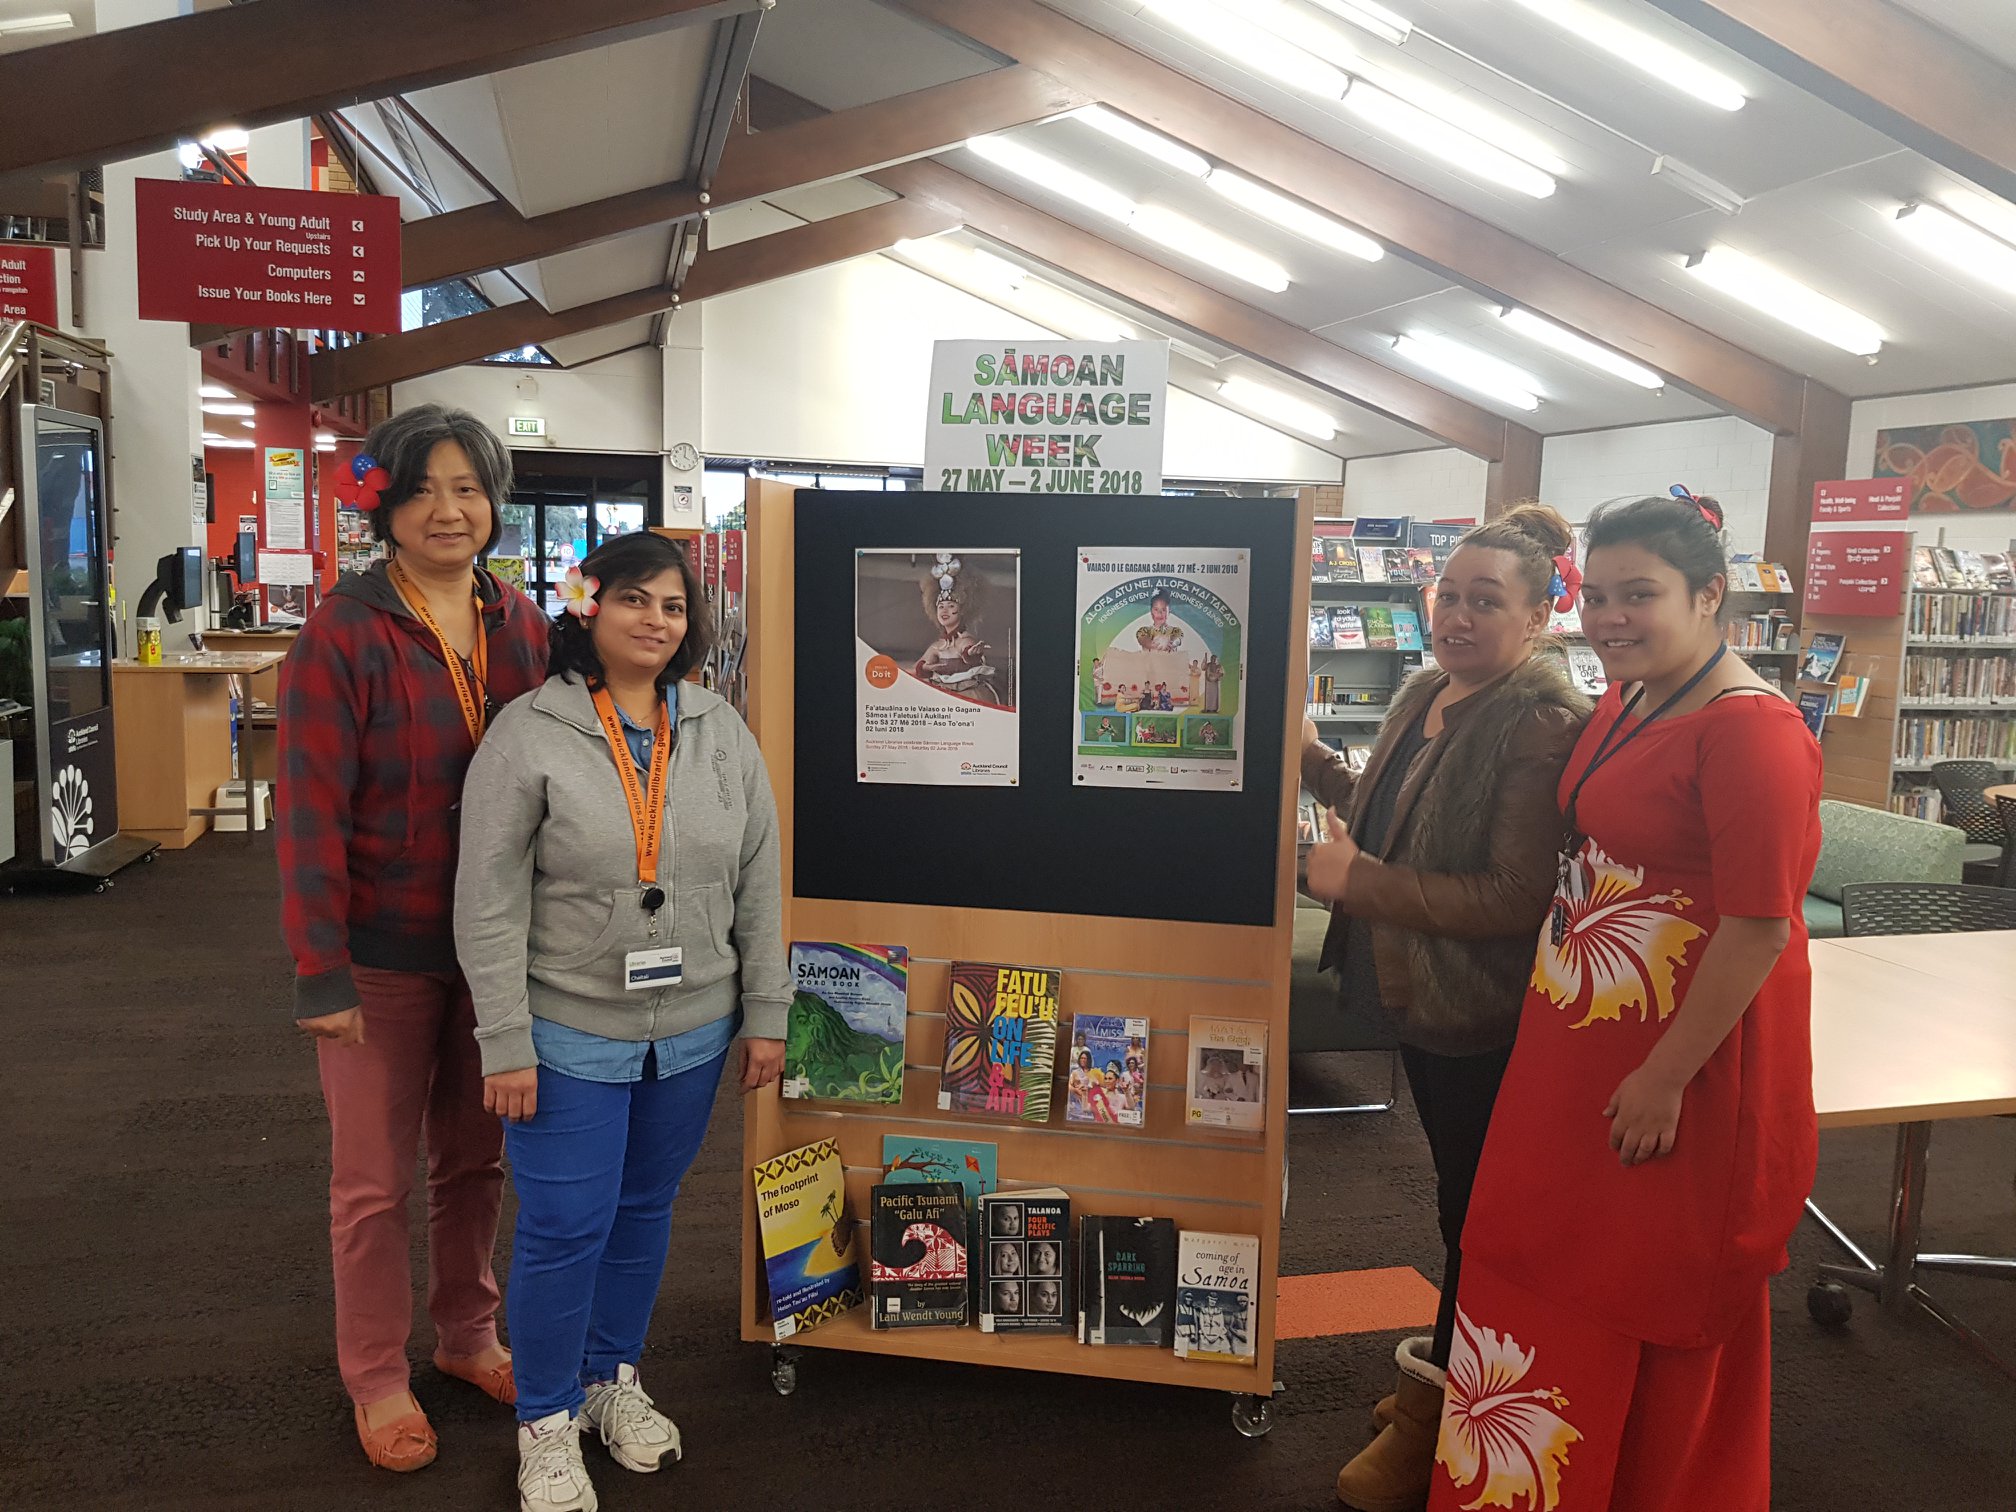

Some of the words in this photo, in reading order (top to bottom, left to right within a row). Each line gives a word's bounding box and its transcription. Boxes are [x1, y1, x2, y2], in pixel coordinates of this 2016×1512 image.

[174, 207, 208, 224] Study
[213, 210, 240, 223] Area
[245, 213, 254, 224] &
[259, 213, 295, 229] Young
[300, 216, 330, 230] Adult
[306, 232, 331, 240] Upstairs
[196, 234, 220, 248] Pick
[225, 236, 240, 251] Up
[244, 238, 271, 251] Your
[276, 240, 331, 255] Requests
[2, 259, 26, 270] Adult
[268, 264, 331, 280] Computers
[199, 285, 230, 299] Issue
[234, 287, 262, 300] Your
[266, 289, 300, 303] Books
[305, 292, 332, 305] Here
[4, 304, 26, 315] Area
[974, 348, 1125, 386] SĀMOAN
[941, 392, 1151, 425] LANGUAGE
[516, 420, 538, 433] EXIT
[986, 434, 1102, 468] WEEK
[941, 469, 962, 492] 27
[967, 469, 1005, 492] MAY
[1030, 470, 1041, 492] 2
[1046, 470, 1094, 493] JUNE
[1099, 471, 1142, 494] 2018
[1429, 534, 1447, 546] TOP
[1449, 535, 1464, 547] PIC
[1087, 563, 1111, 573] VAIASO
[1112, 563, 1116, 573] O
[1117, 563, 1124, 573] LE
[1125, 563, 1150, 573] GAGANA
[1177, 564, 1186, 574] 27
[1201, 565, 1205, 574] 2
[1221, 565, 1238, 574] 2018
[1085, 597, 1114, 625] ALOFA
[1114, 584, 1133, 599] ATU
[1156, 578, 1189, 592] ALOFA
[1191, 586, 1210, 600] MAI
[1210, 595, 1237, 626] TAEAO
[1098, 598, 1128, 624] KINDNESS
[1128, 591, 1149, 604] GIVEN
[1170, 590, 1203, 608] KINDNESS
[872, 670, 884, 678] Do
[885, 670, 891, 678] it
[1577, 664, 1598, 672] YEAR
[1581, 670, 1596, 678] ONE
[955, 706, 981, 714] Gagana
[798, 963, 860, 981] SĀMOAN
[997, 969, 1048, 997] FATU
[995, 992, 1054, 1021] FEU'U
[993, 1015, 1024, 1041] ON
[1100, 1028, 1122, 1037] MISS
[990, 1040, 1034, 1067] LIFE
[989, 1063, 1005, 1087] &
[985, 1087, 1029, 1114] ART
[1192, 1110, 1202, 1118] PG
[761, 1186, 779, 1202] The
[780, 1172, 819, 1198] footprint
[763, 1206, 774, 1218] of
[775, 1198, 800, 1216] Moso
[880, 1194, 913, 1207] Pacific
[915, 1193, 958, 1206] Tsunami
[1116, 1252, 1137, 1261] DARK
[1196, 1252, 1228, 1264] coming
[1230, 1252, 1240, 1265] of
[1108, 1262, 1145, 1273] SPARRING
[1219, 1265, 1234, 1275] age
[1235, 1265, 1245, 1274] in
[1182, 1267, 1249, 1290] Samoa
[917, 1300, 926, 1308] by
[880, 1312, 899, 1322] Lani
[902, 1310, 932, 1321] Wendt
[934, 1309, 964, 1320] Young
